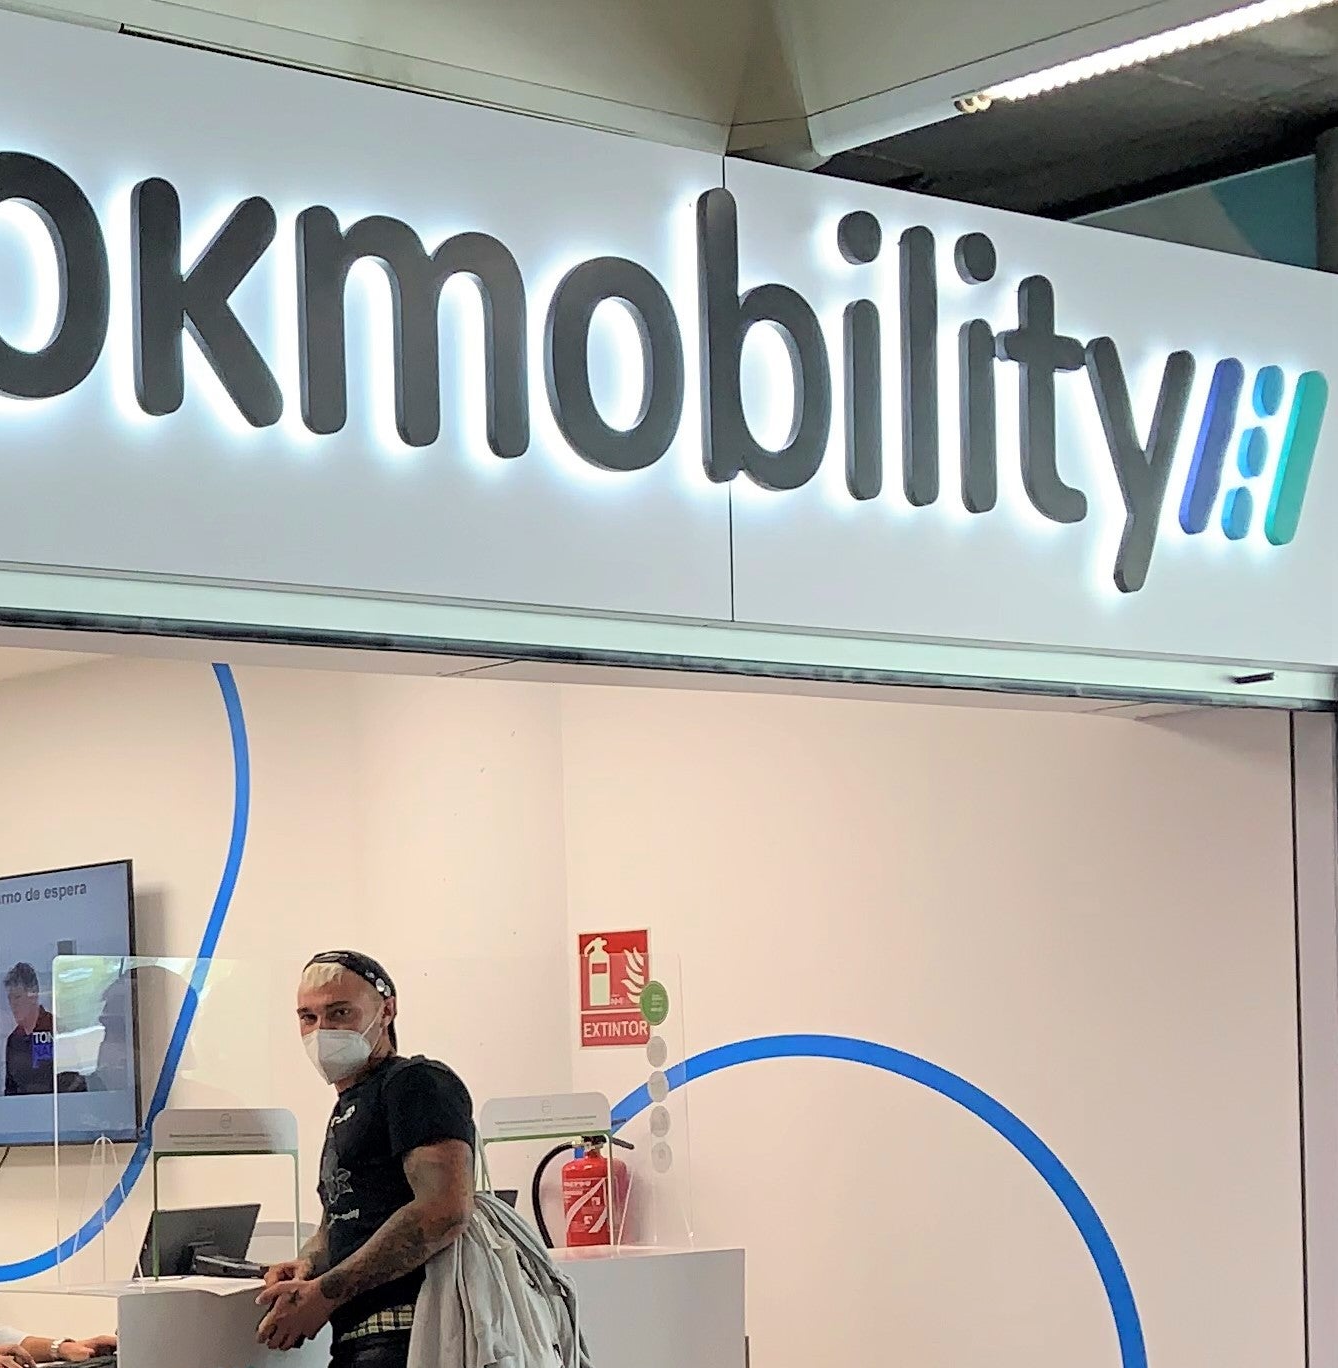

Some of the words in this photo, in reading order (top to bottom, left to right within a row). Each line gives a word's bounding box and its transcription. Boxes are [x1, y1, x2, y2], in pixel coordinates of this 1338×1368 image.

[25, 887, 40, 901] de
[44, 883, 87, 901] espera
[584, 1020, 649, 1038] EXTINTOR
